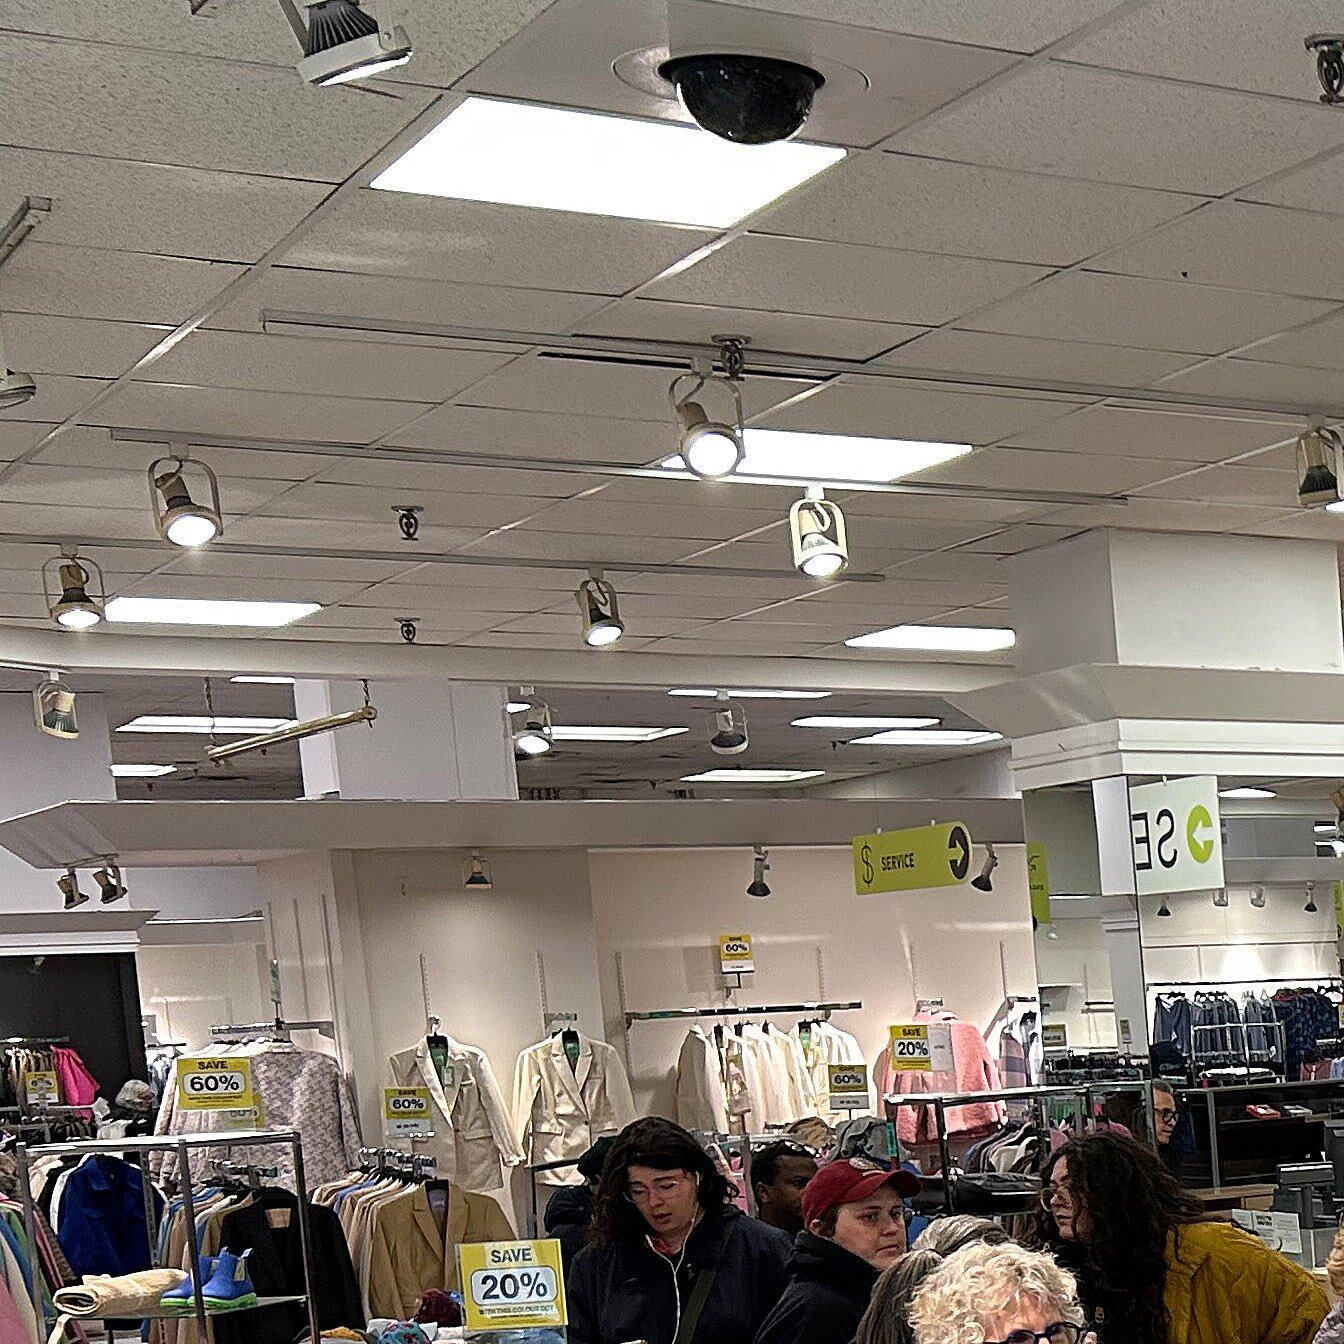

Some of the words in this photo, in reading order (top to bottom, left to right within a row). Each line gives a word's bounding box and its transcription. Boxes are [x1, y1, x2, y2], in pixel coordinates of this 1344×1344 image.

[881, 852, 915, 872] SERVICE
[902, 1027, 922, 1037] SAVE
[897, 1041, 928, 1056] 20%
[197, 1060, 228, 1070] SAVE
[189, 1074, 240, 1092] 60%
[833, 1074, 862, 1084] 60%
[392, 1098, 424, 1109] 60%
[491, 1248, 532, 1263] SAVE
[481, 1272, 548, 1301] 20%
